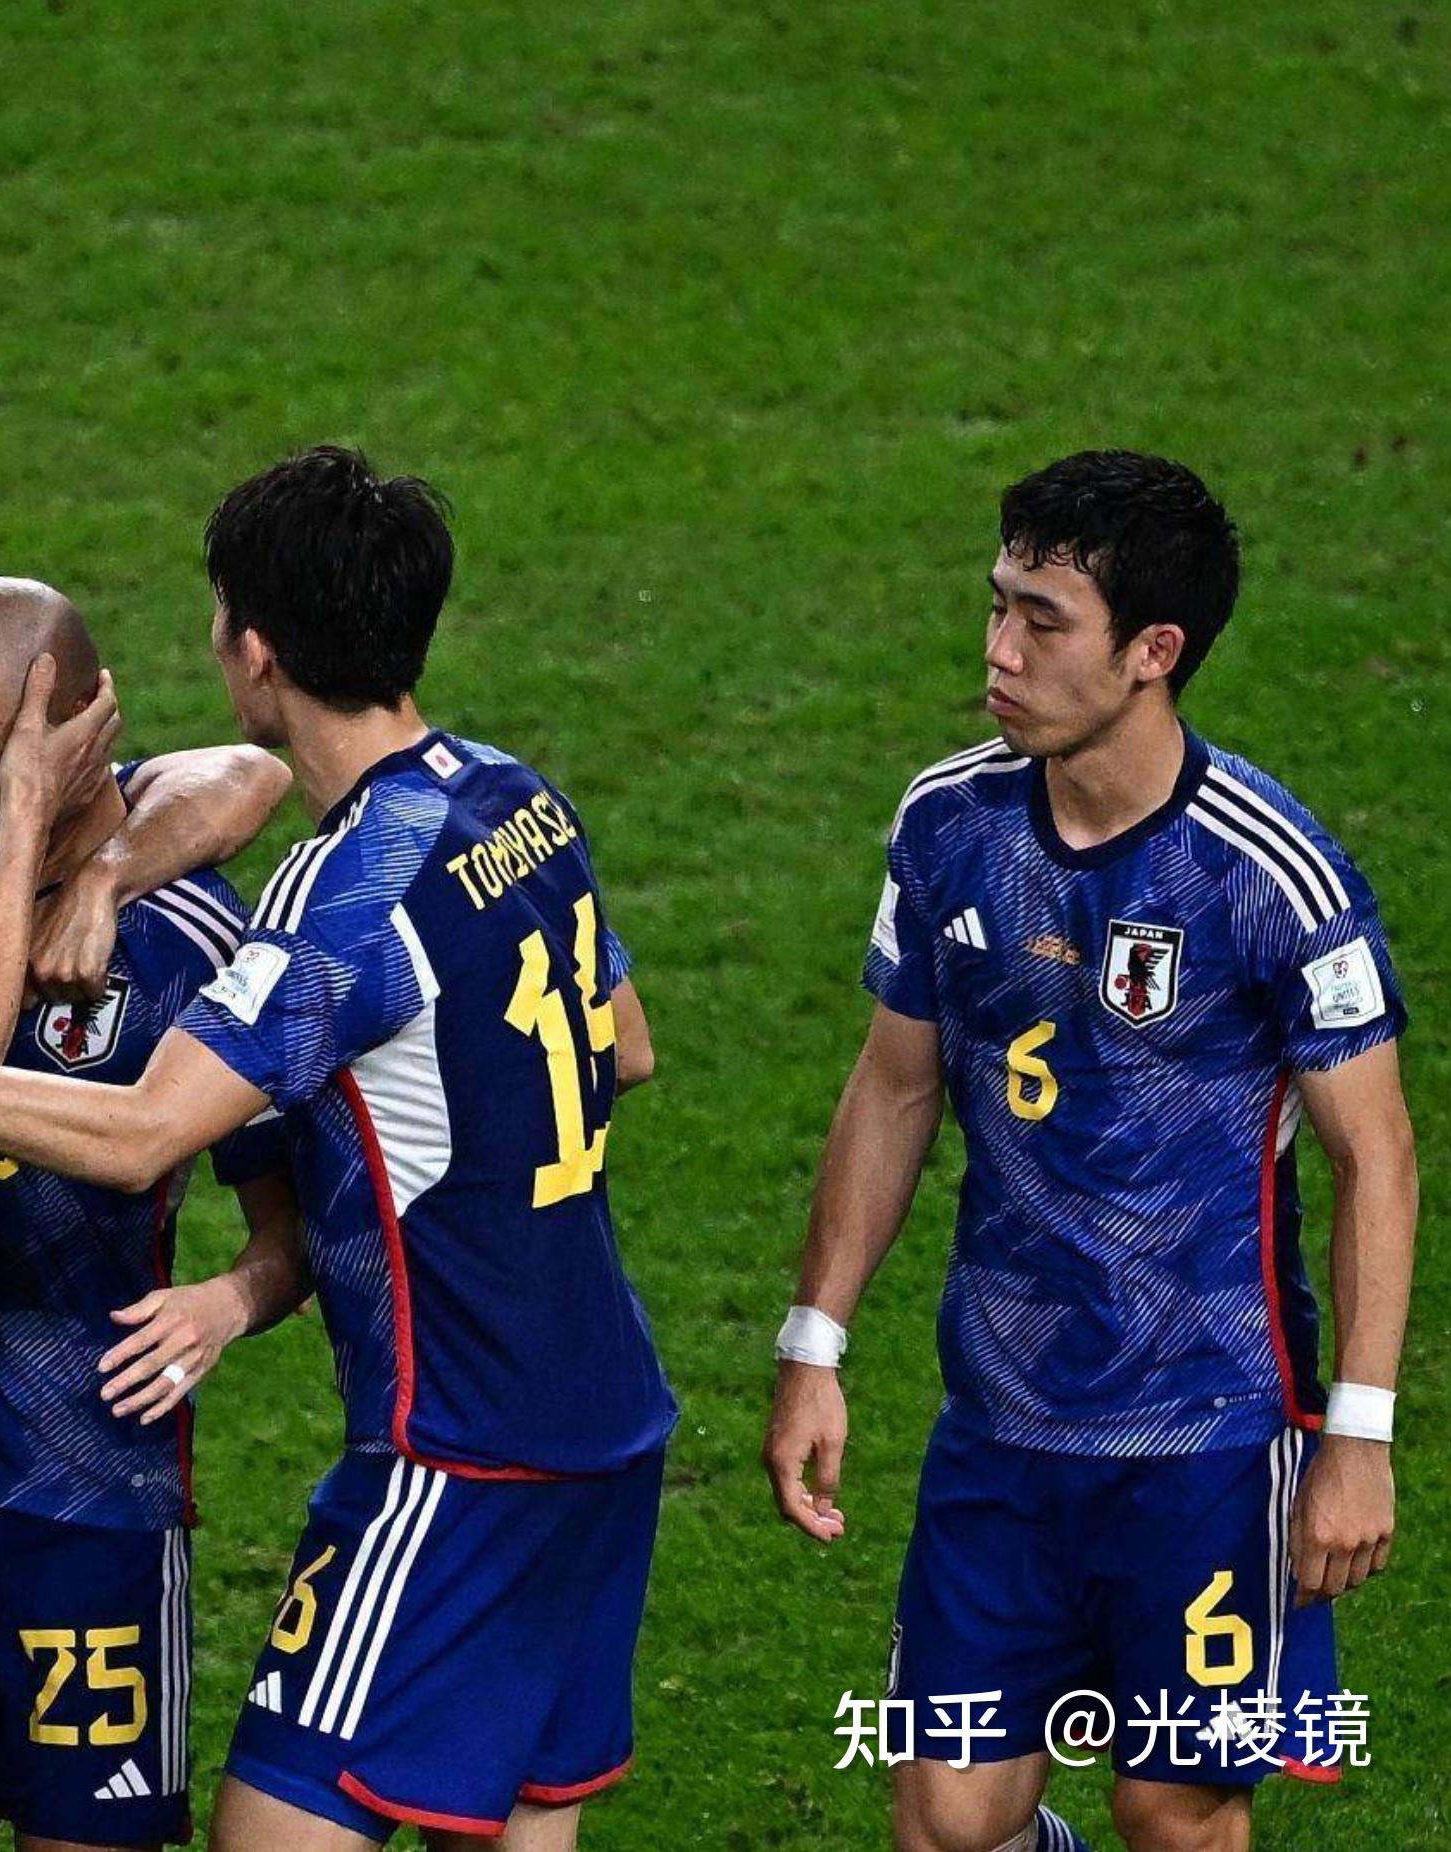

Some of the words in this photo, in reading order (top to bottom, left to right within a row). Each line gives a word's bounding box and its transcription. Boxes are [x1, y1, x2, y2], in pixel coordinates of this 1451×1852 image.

[1123, 926, 1164, 940] JAPAN
[1006, 1020, 1059, 1121] 6
[271, 1545, 336, 1654] 6
[1184, 1570, 1254, 1687] 6
[19, 1625, 148, 1747] 25
